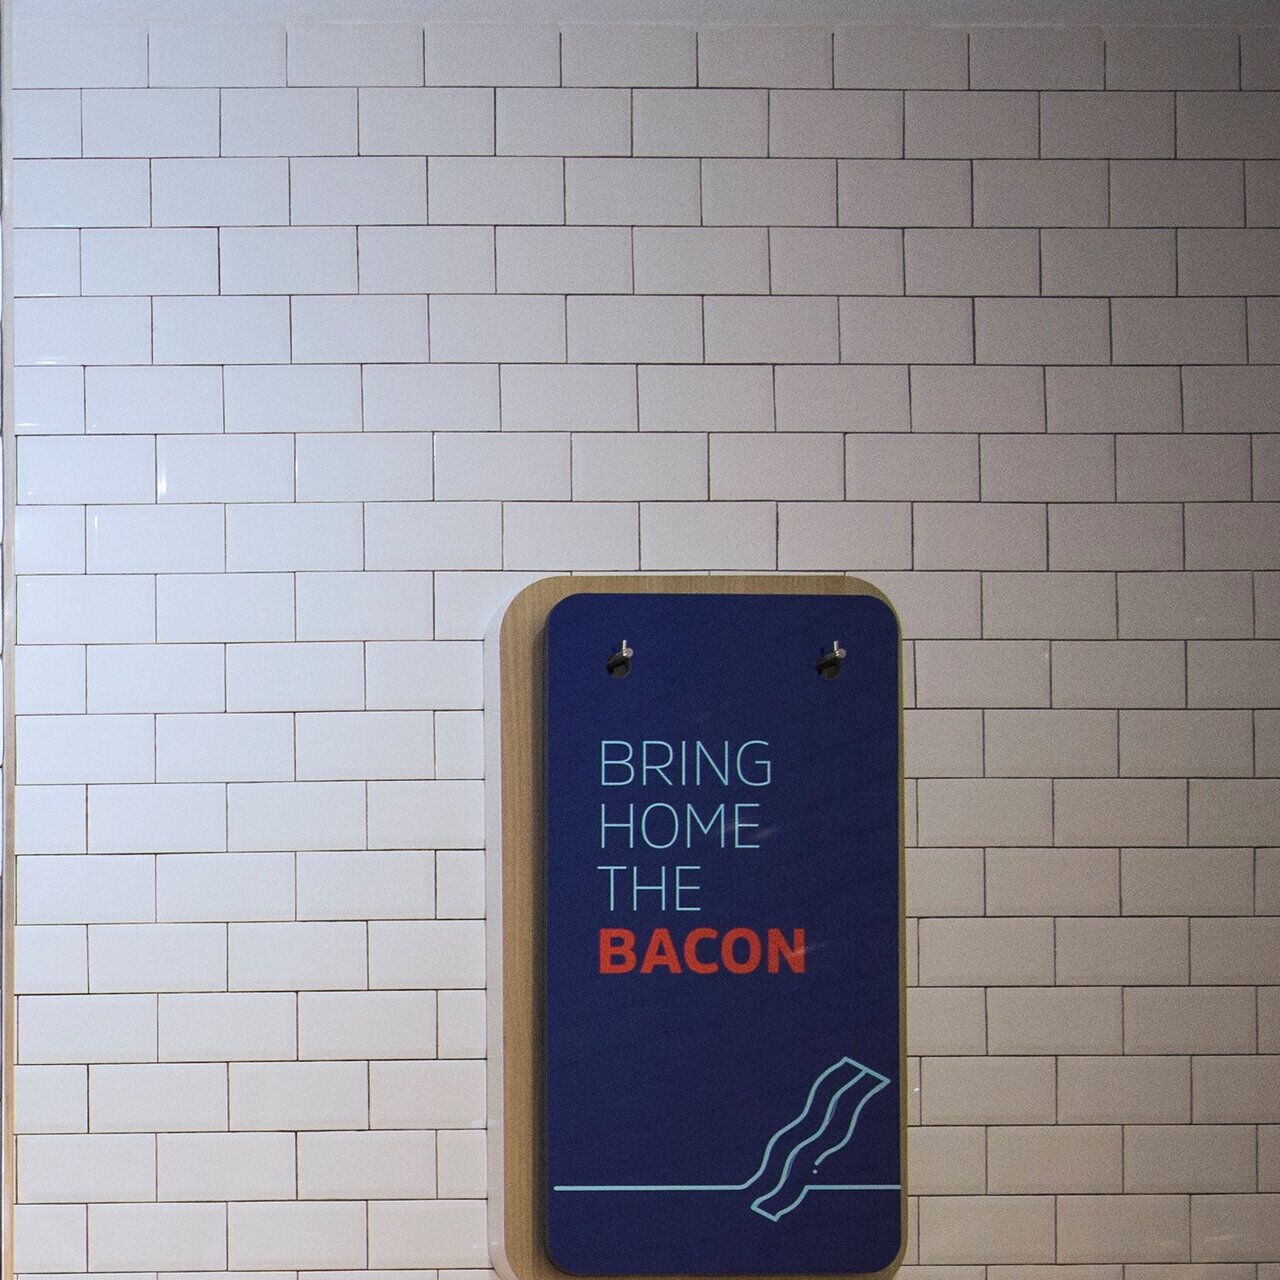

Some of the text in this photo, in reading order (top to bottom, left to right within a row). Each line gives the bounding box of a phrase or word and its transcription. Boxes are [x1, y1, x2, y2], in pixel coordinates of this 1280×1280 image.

[599, 740, 772, 787] BRING
[600, 802, 761, 850] HOME
[597, 865, 702, 912] THE
[599, 926, 807, 975] BACON
